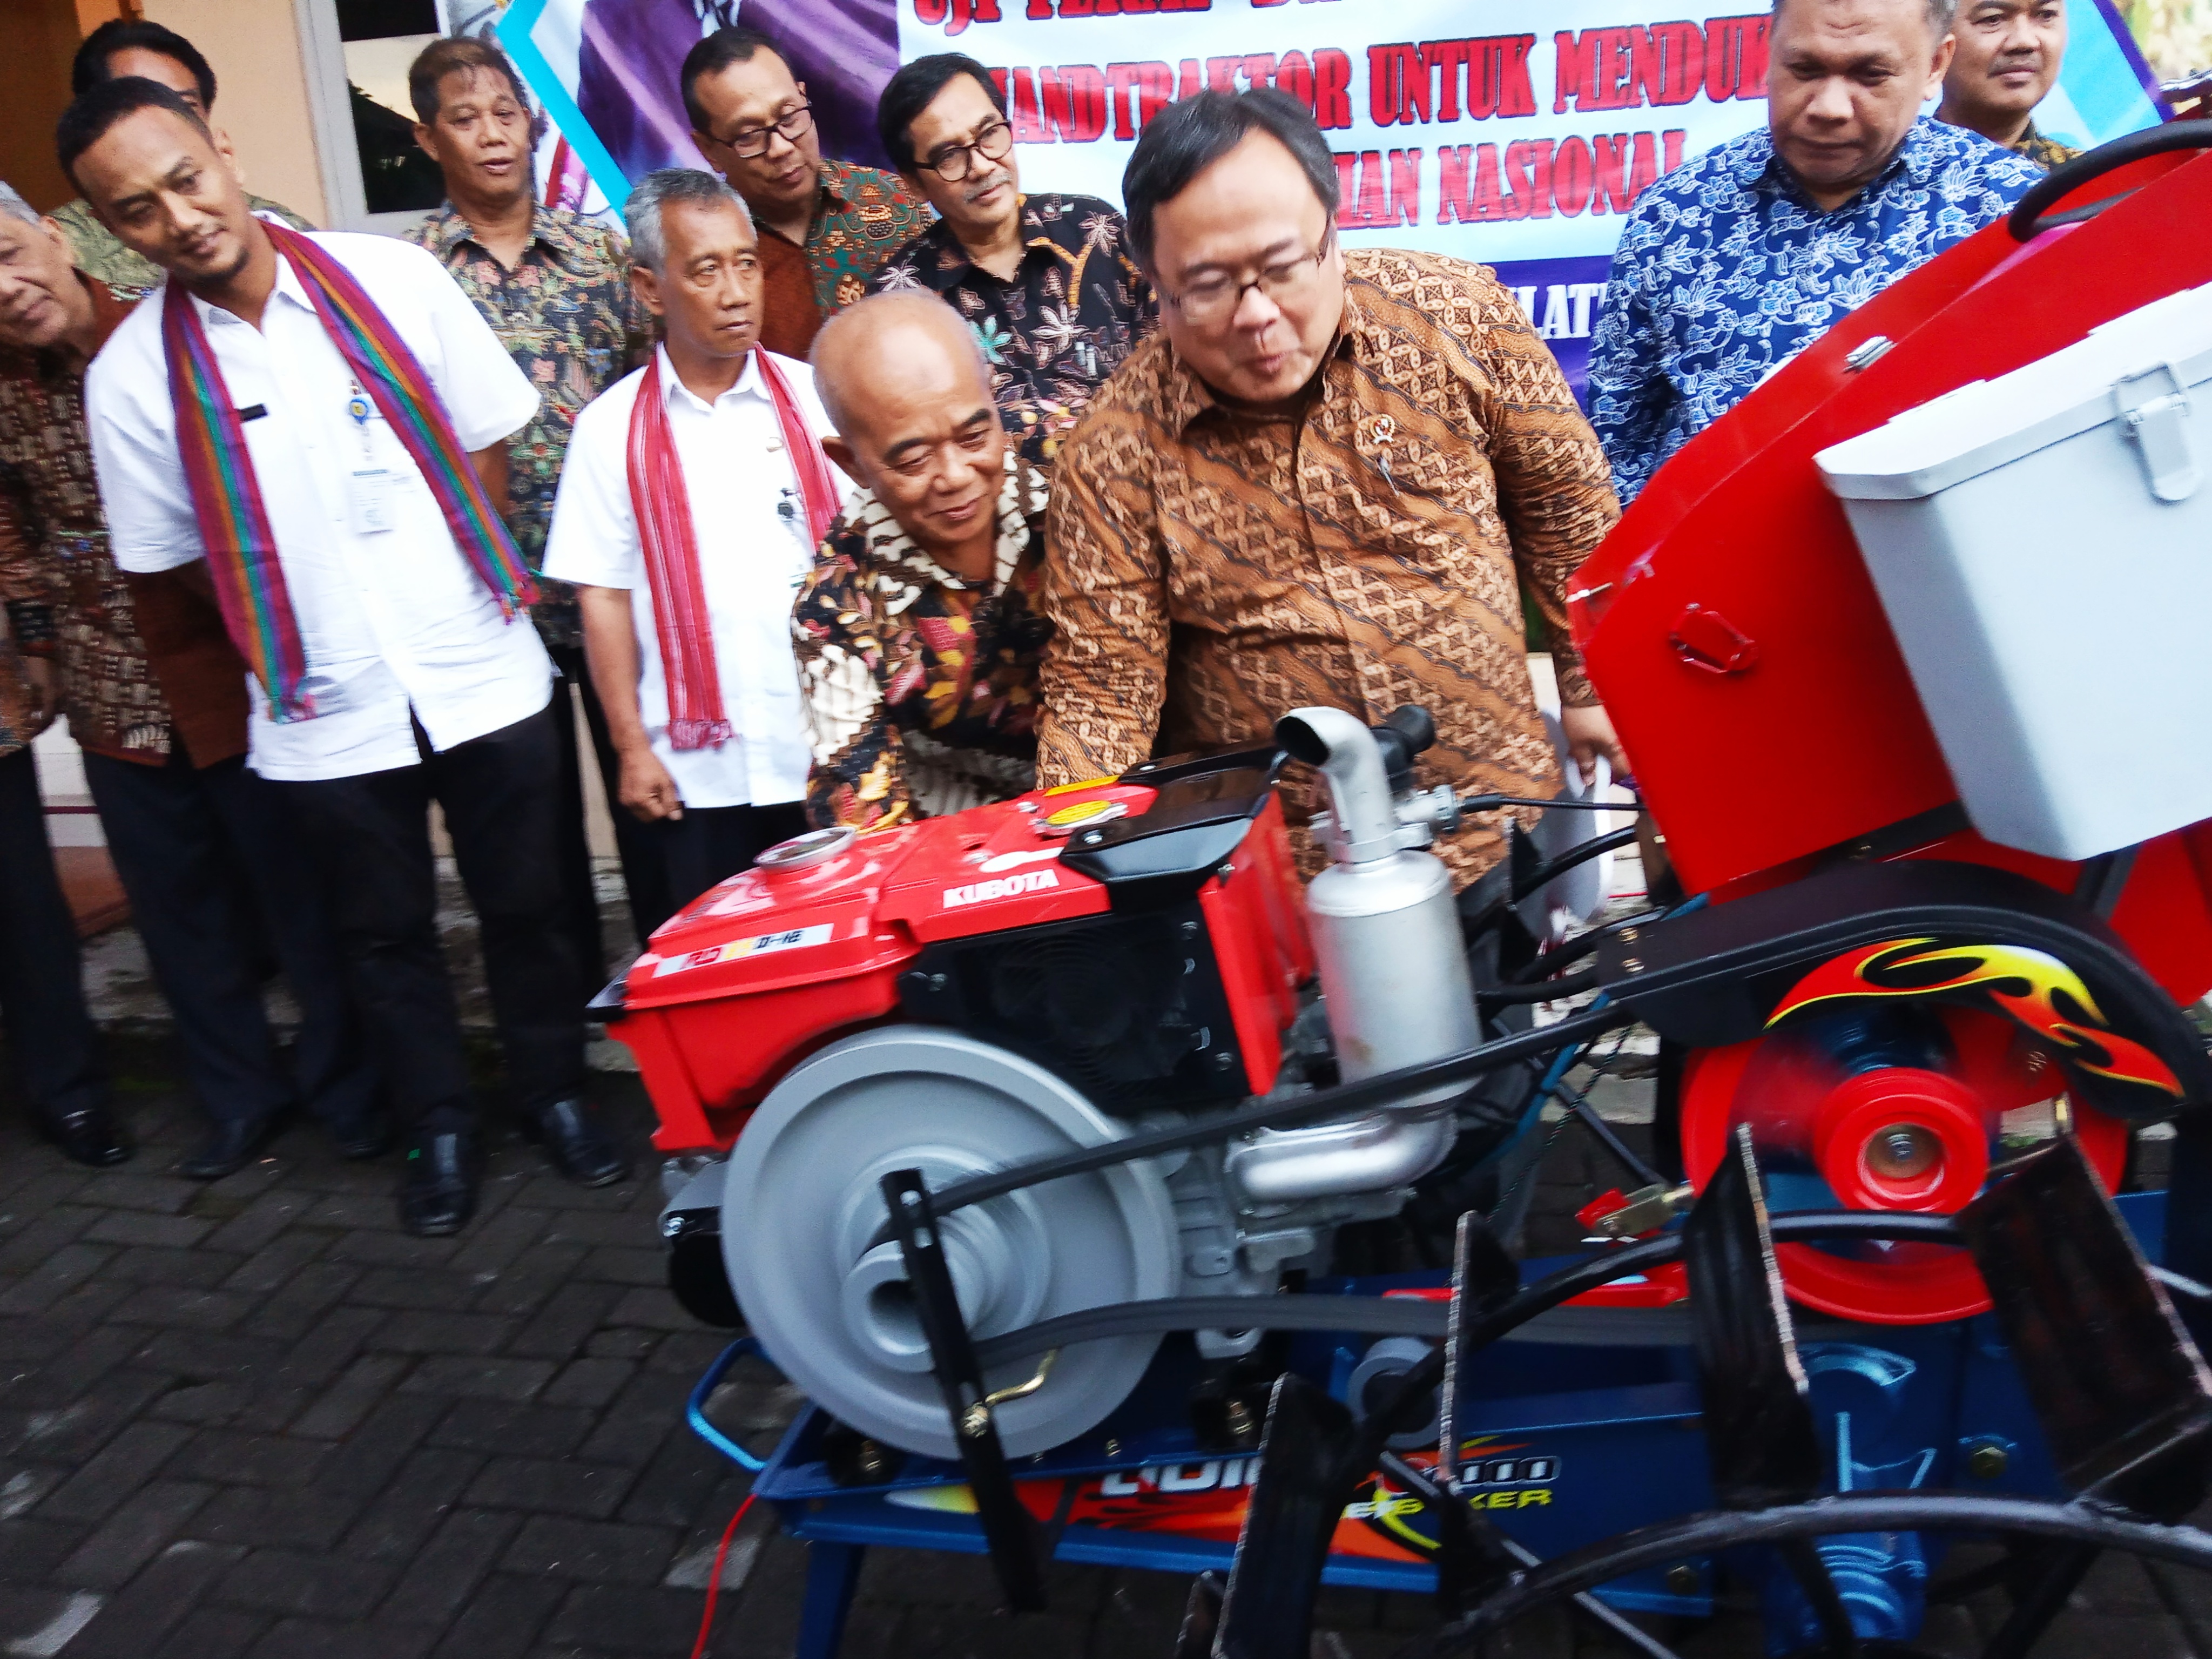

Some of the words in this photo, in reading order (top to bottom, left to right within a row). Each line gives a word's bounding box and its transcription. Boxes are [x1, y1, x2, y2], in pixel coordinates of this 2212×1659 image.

[1367, 33, 1537, 127] UNTUK
[1554, 13, 1773, 114] MENDUK
[942, 868, 1061, 909] KUBOTA
